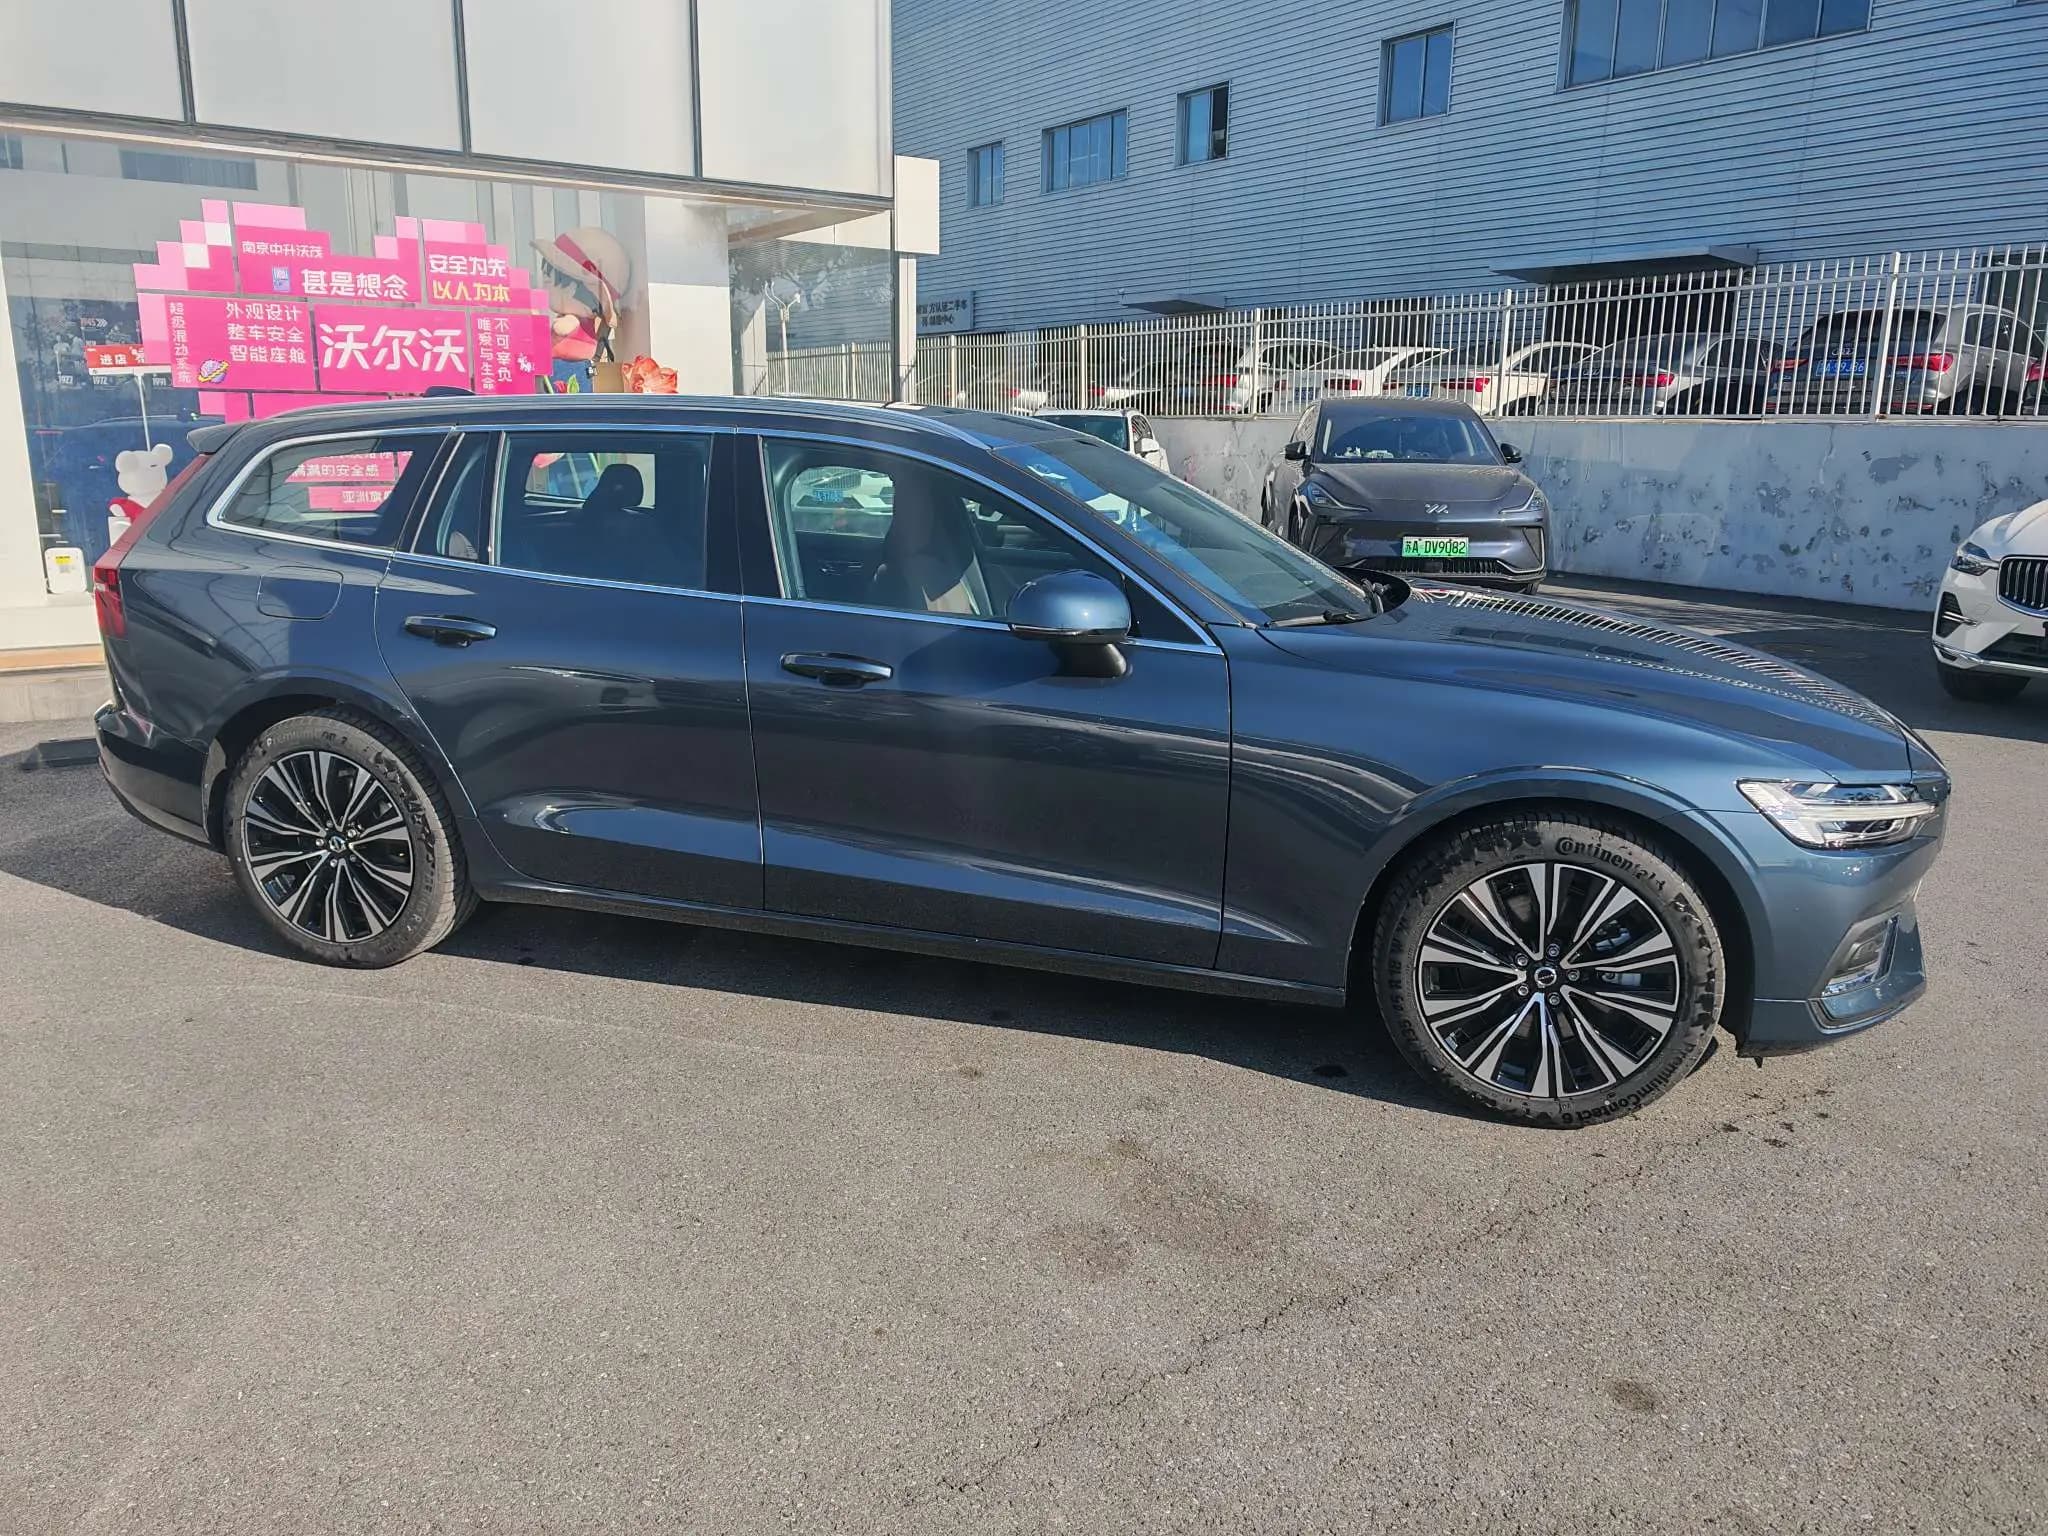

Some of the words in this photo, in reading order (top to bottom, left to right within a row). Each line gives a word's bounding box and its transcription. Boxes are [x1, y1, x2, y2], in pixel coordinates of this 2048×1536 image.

[241, 241, 323, 258] 南京中升沃茂
[429, 254, 506, 277] 安全为先
[301, 269, 408, 299] 甚是想念
[432, 280, 511, 302] 以人为本
[225, 302, 301, 321] 外观设计
[169, 302, 192, 383] 超级混动系统
[227, 323, 304, 342] 整车安全
[229, 344, 306, 364] 智能座舱
[319, 323, 466, 372] 沃尔沃
[1576, 1042, 1697, 1122] PremiumContact
